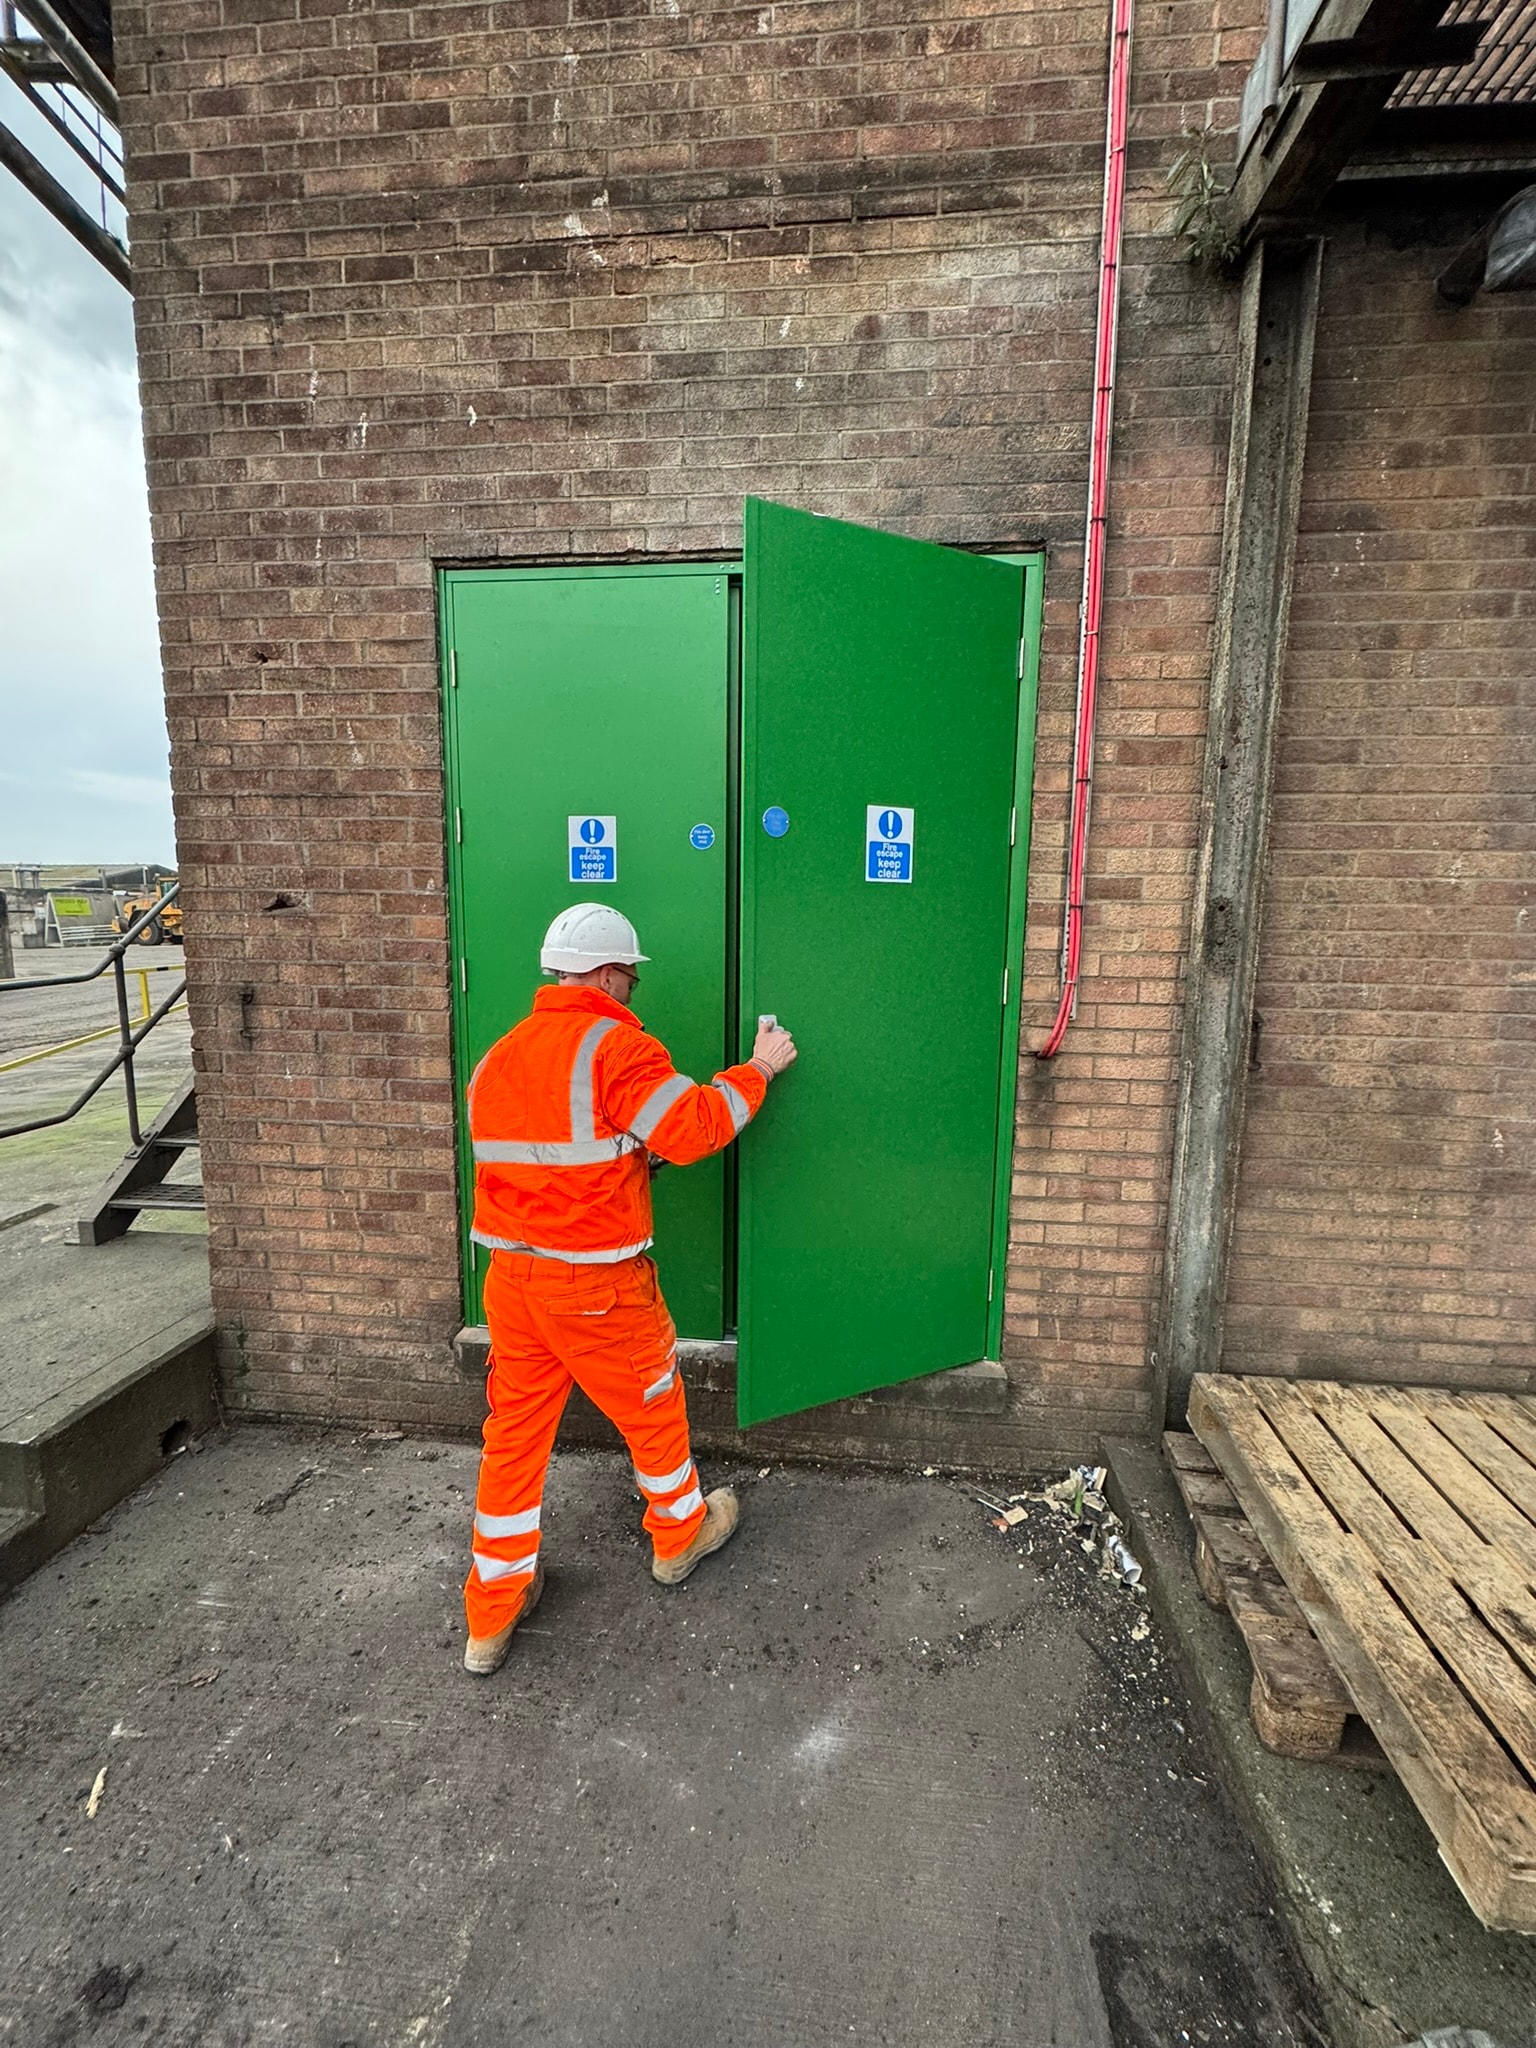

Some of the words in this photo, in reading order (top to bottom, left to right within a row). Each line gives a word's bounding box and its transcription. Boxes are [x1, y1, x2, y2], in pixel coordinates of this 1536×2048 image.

[585, 847, 600, 855] Fire
[883, 843, 897, 851] Fire
[579, 854, 607, 862] escape
[876, 850, 903, 860] escape
[581, 861, 605, 871] keep
[878, 858, 901, 870] keep
[581, 870, 605, 879] clear
[877, 868, 901, 878] clear
